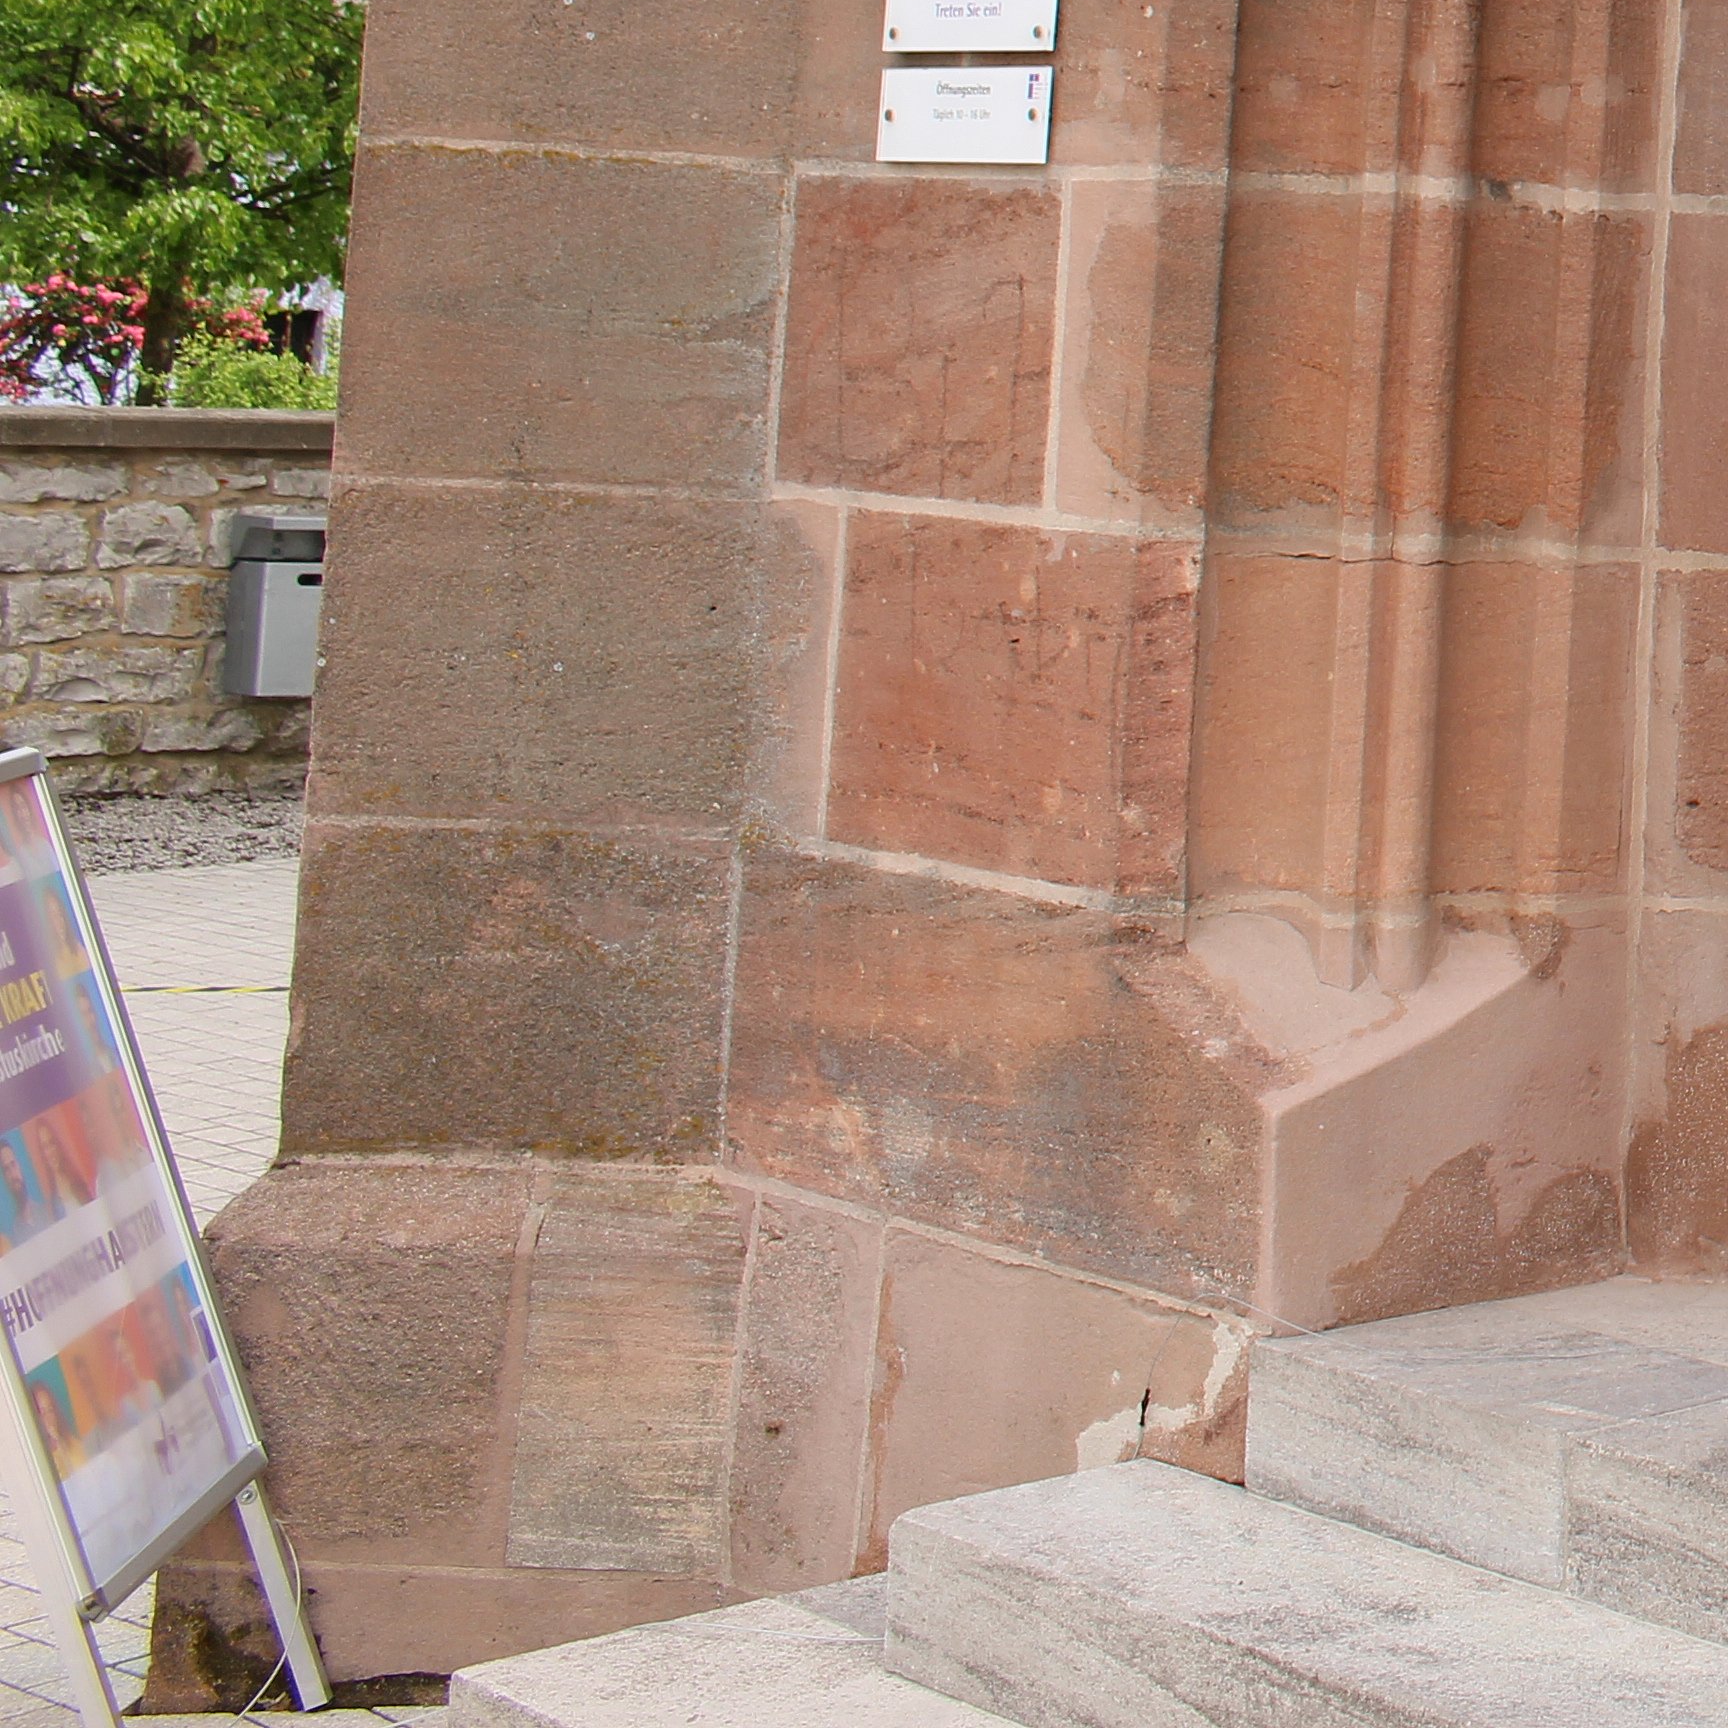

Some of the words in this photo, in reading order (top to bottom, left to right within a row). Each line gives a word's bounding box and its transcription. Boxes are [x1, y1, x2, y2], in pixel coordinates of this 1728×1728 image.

[935, 3, 964, 18] Treten
[966, 2, 981, 18] Sie
[984, 2, 1002, 17] ein!
[936, 81, 991, 98] Öffnungszeiten
[980, 109, 991, 120] Uhr
